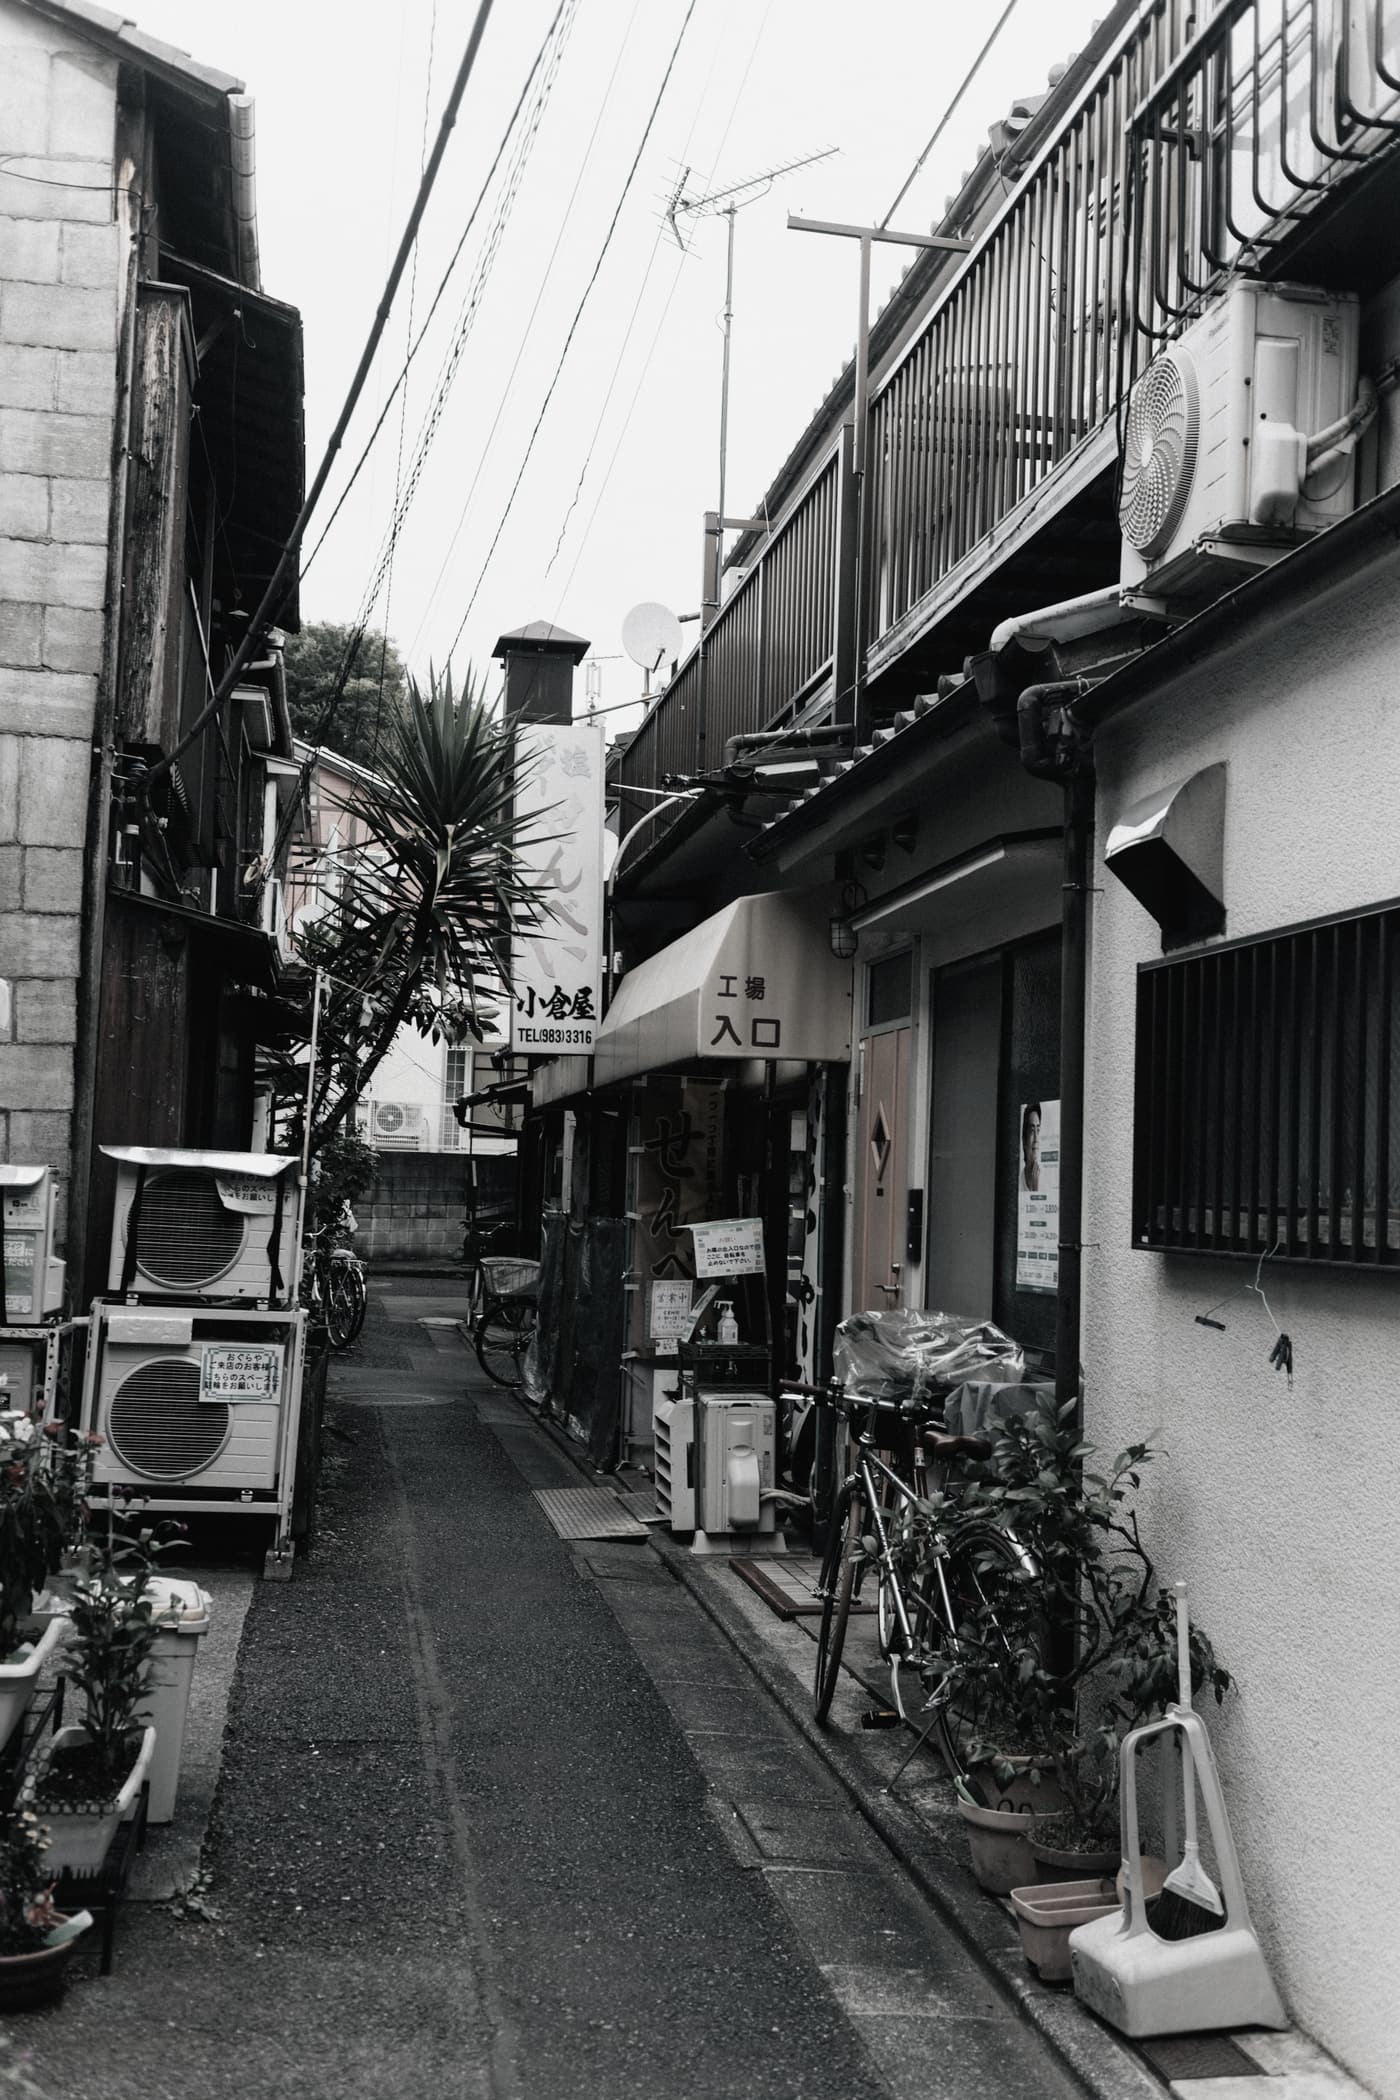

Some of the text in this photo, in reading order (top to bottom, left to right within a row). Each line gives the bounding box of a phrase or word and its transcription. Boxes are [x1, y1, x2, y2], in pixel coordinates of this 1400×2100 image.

[717, 975, 766, 1001] 工場
[516, 985, 596, 1021] 小倉屋
[518, 1027, 592, 1044] TEL(983)3316
[710, 1015, 781, 1048] 入口
[209, 1361, 279, 1371] ご来店のお客様へ
[227, 1353, 263, 1362] おぐらや
